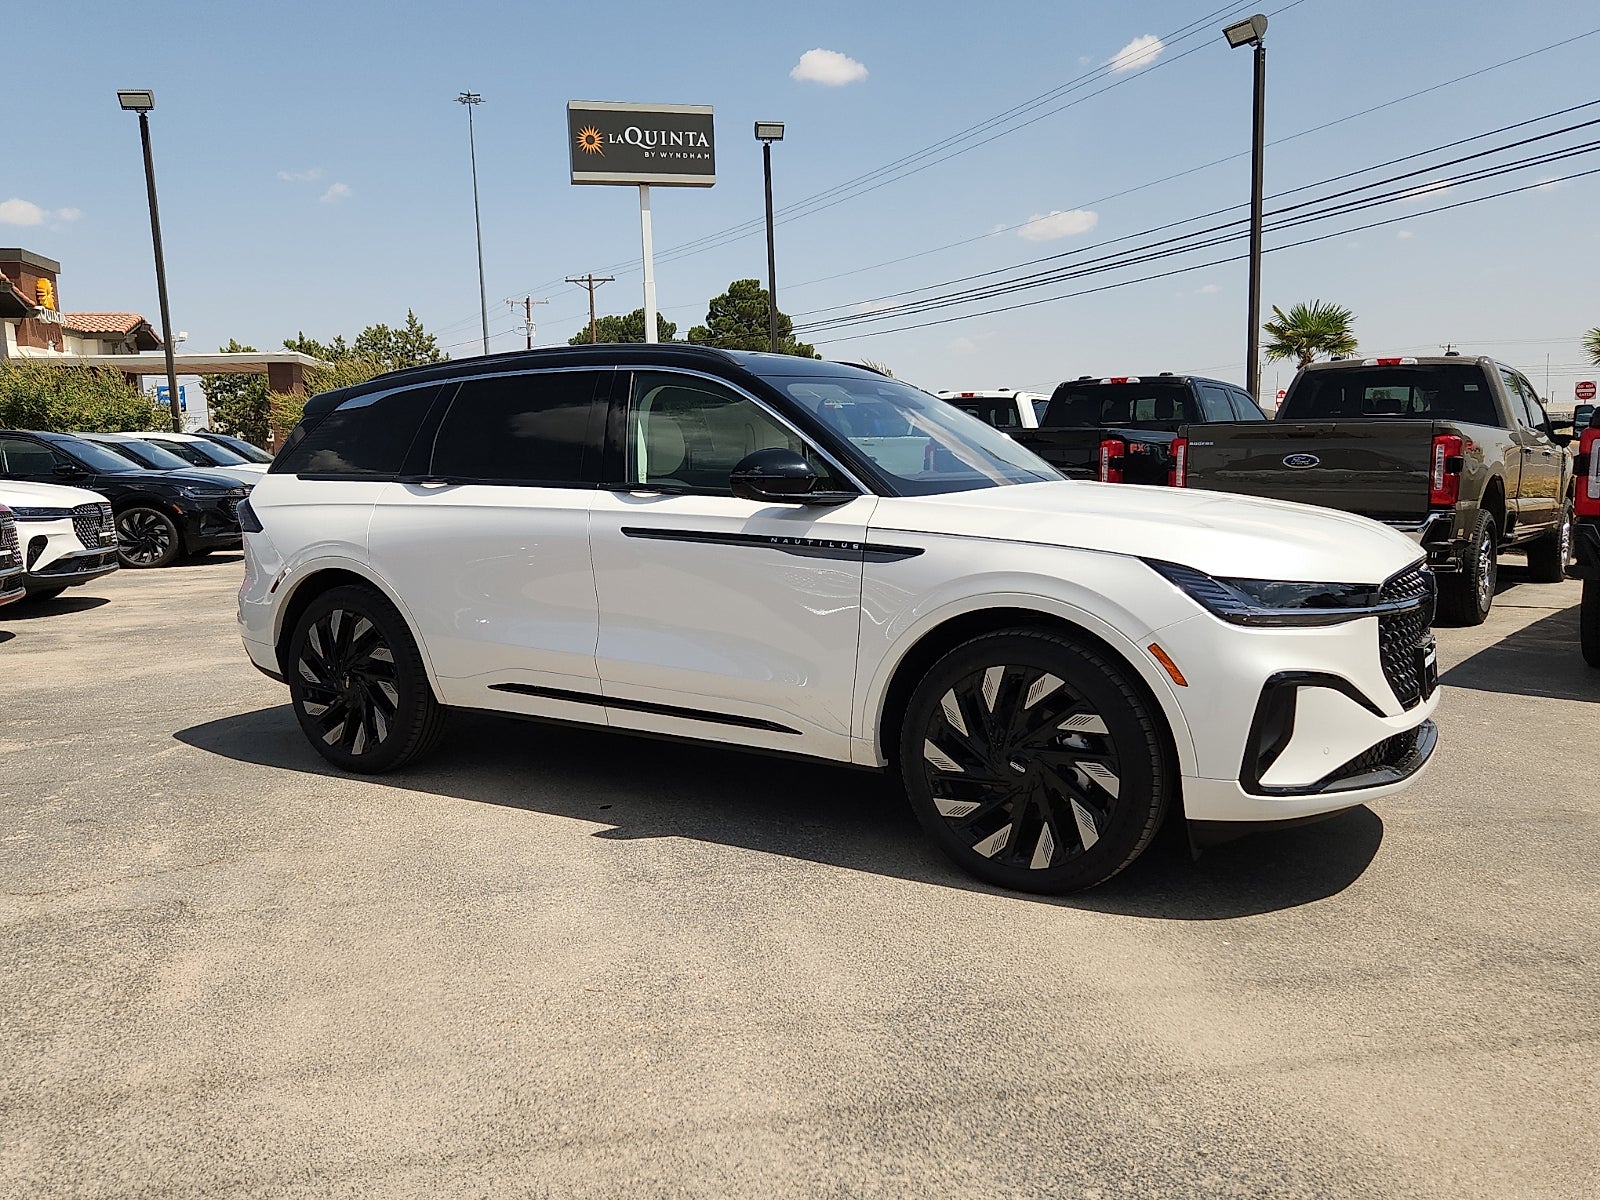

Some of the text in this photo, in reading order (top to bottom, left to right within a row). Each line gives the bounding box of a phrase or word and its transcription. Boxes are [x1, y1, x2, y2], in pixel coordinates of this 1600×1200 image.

[624, 126, 710, 150] QUINTA
[644, 151, 710, 160] BY WYNDHAM
[1290, 456, 1311, 465] Ford
[770, 537, 859, 550] NAUTILUS
